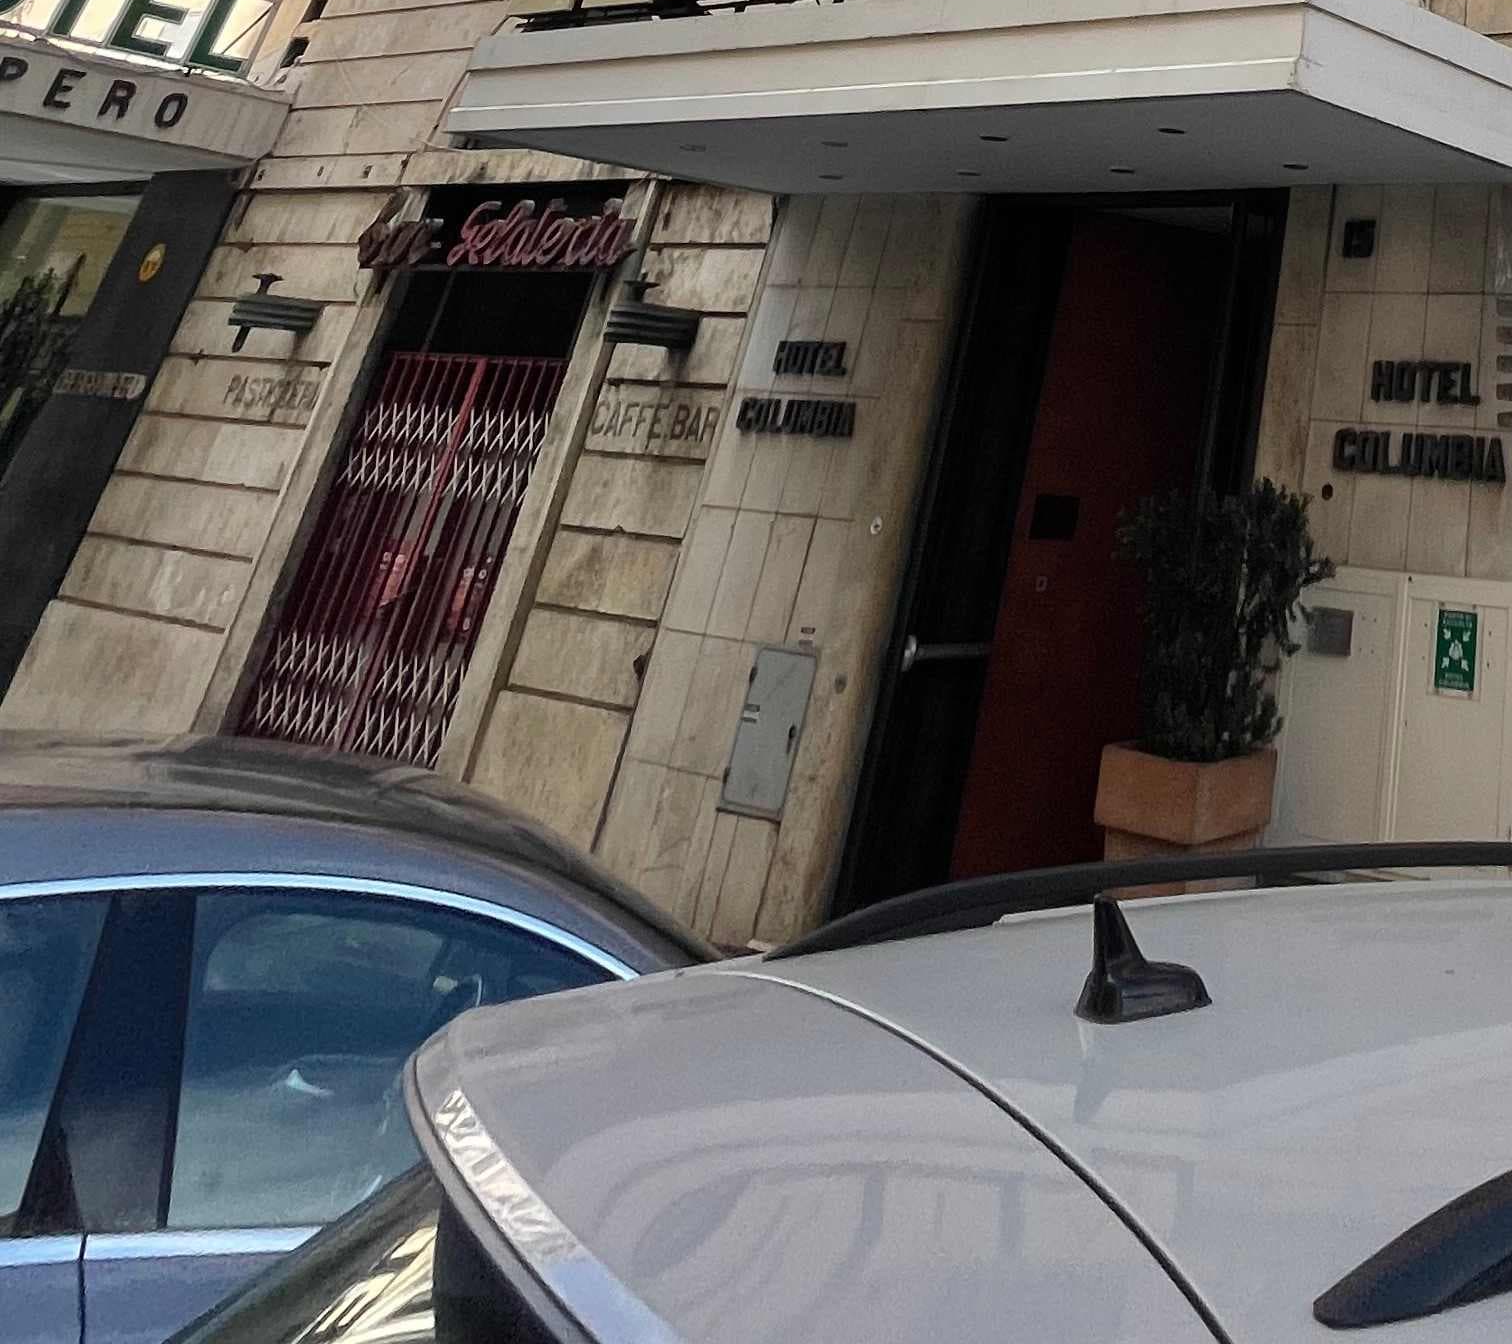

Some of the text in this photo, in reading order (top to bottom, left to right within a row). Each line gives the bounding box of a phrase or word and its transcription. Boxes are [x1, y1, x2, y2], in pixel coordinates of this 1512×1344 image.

[773, 340, 848, 376] HOTEL
[1371, 360, 1480, 404] HOTEL
[736, 397, 856, 438] COLUMBIA
[1332, 427, 1506, 485] COLUMBIA
